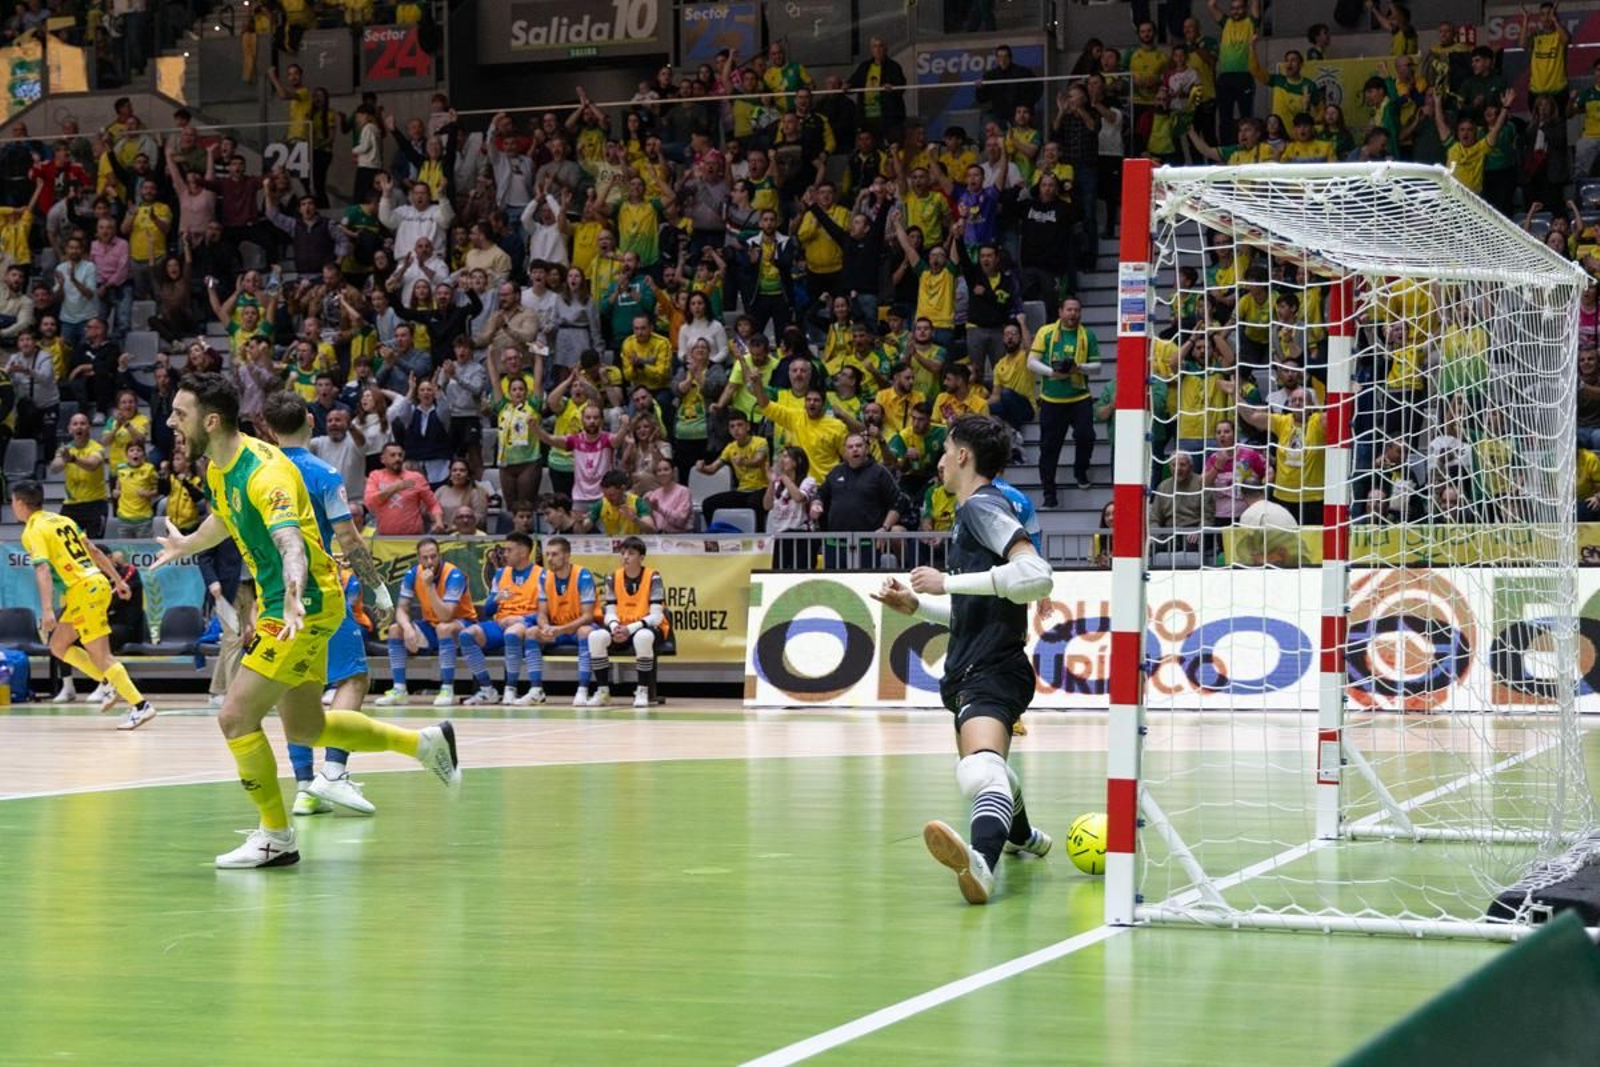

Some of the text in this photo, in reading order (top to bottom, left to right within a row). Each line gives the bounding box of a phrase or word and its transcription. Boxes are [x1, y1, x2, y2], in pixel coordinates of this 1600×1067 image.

[511, 0, 659, 45] Salida 10
[684, 8, 730, 21] Sector
[364, 29, 406, 42] Sector
[363, 26, 433, 80] 24
[917, 52, 997, 75] Sector
[263, 141, 310, 179] 24
[56, 524, 87, 560] 23
[664, 586, 697, 607] REA
